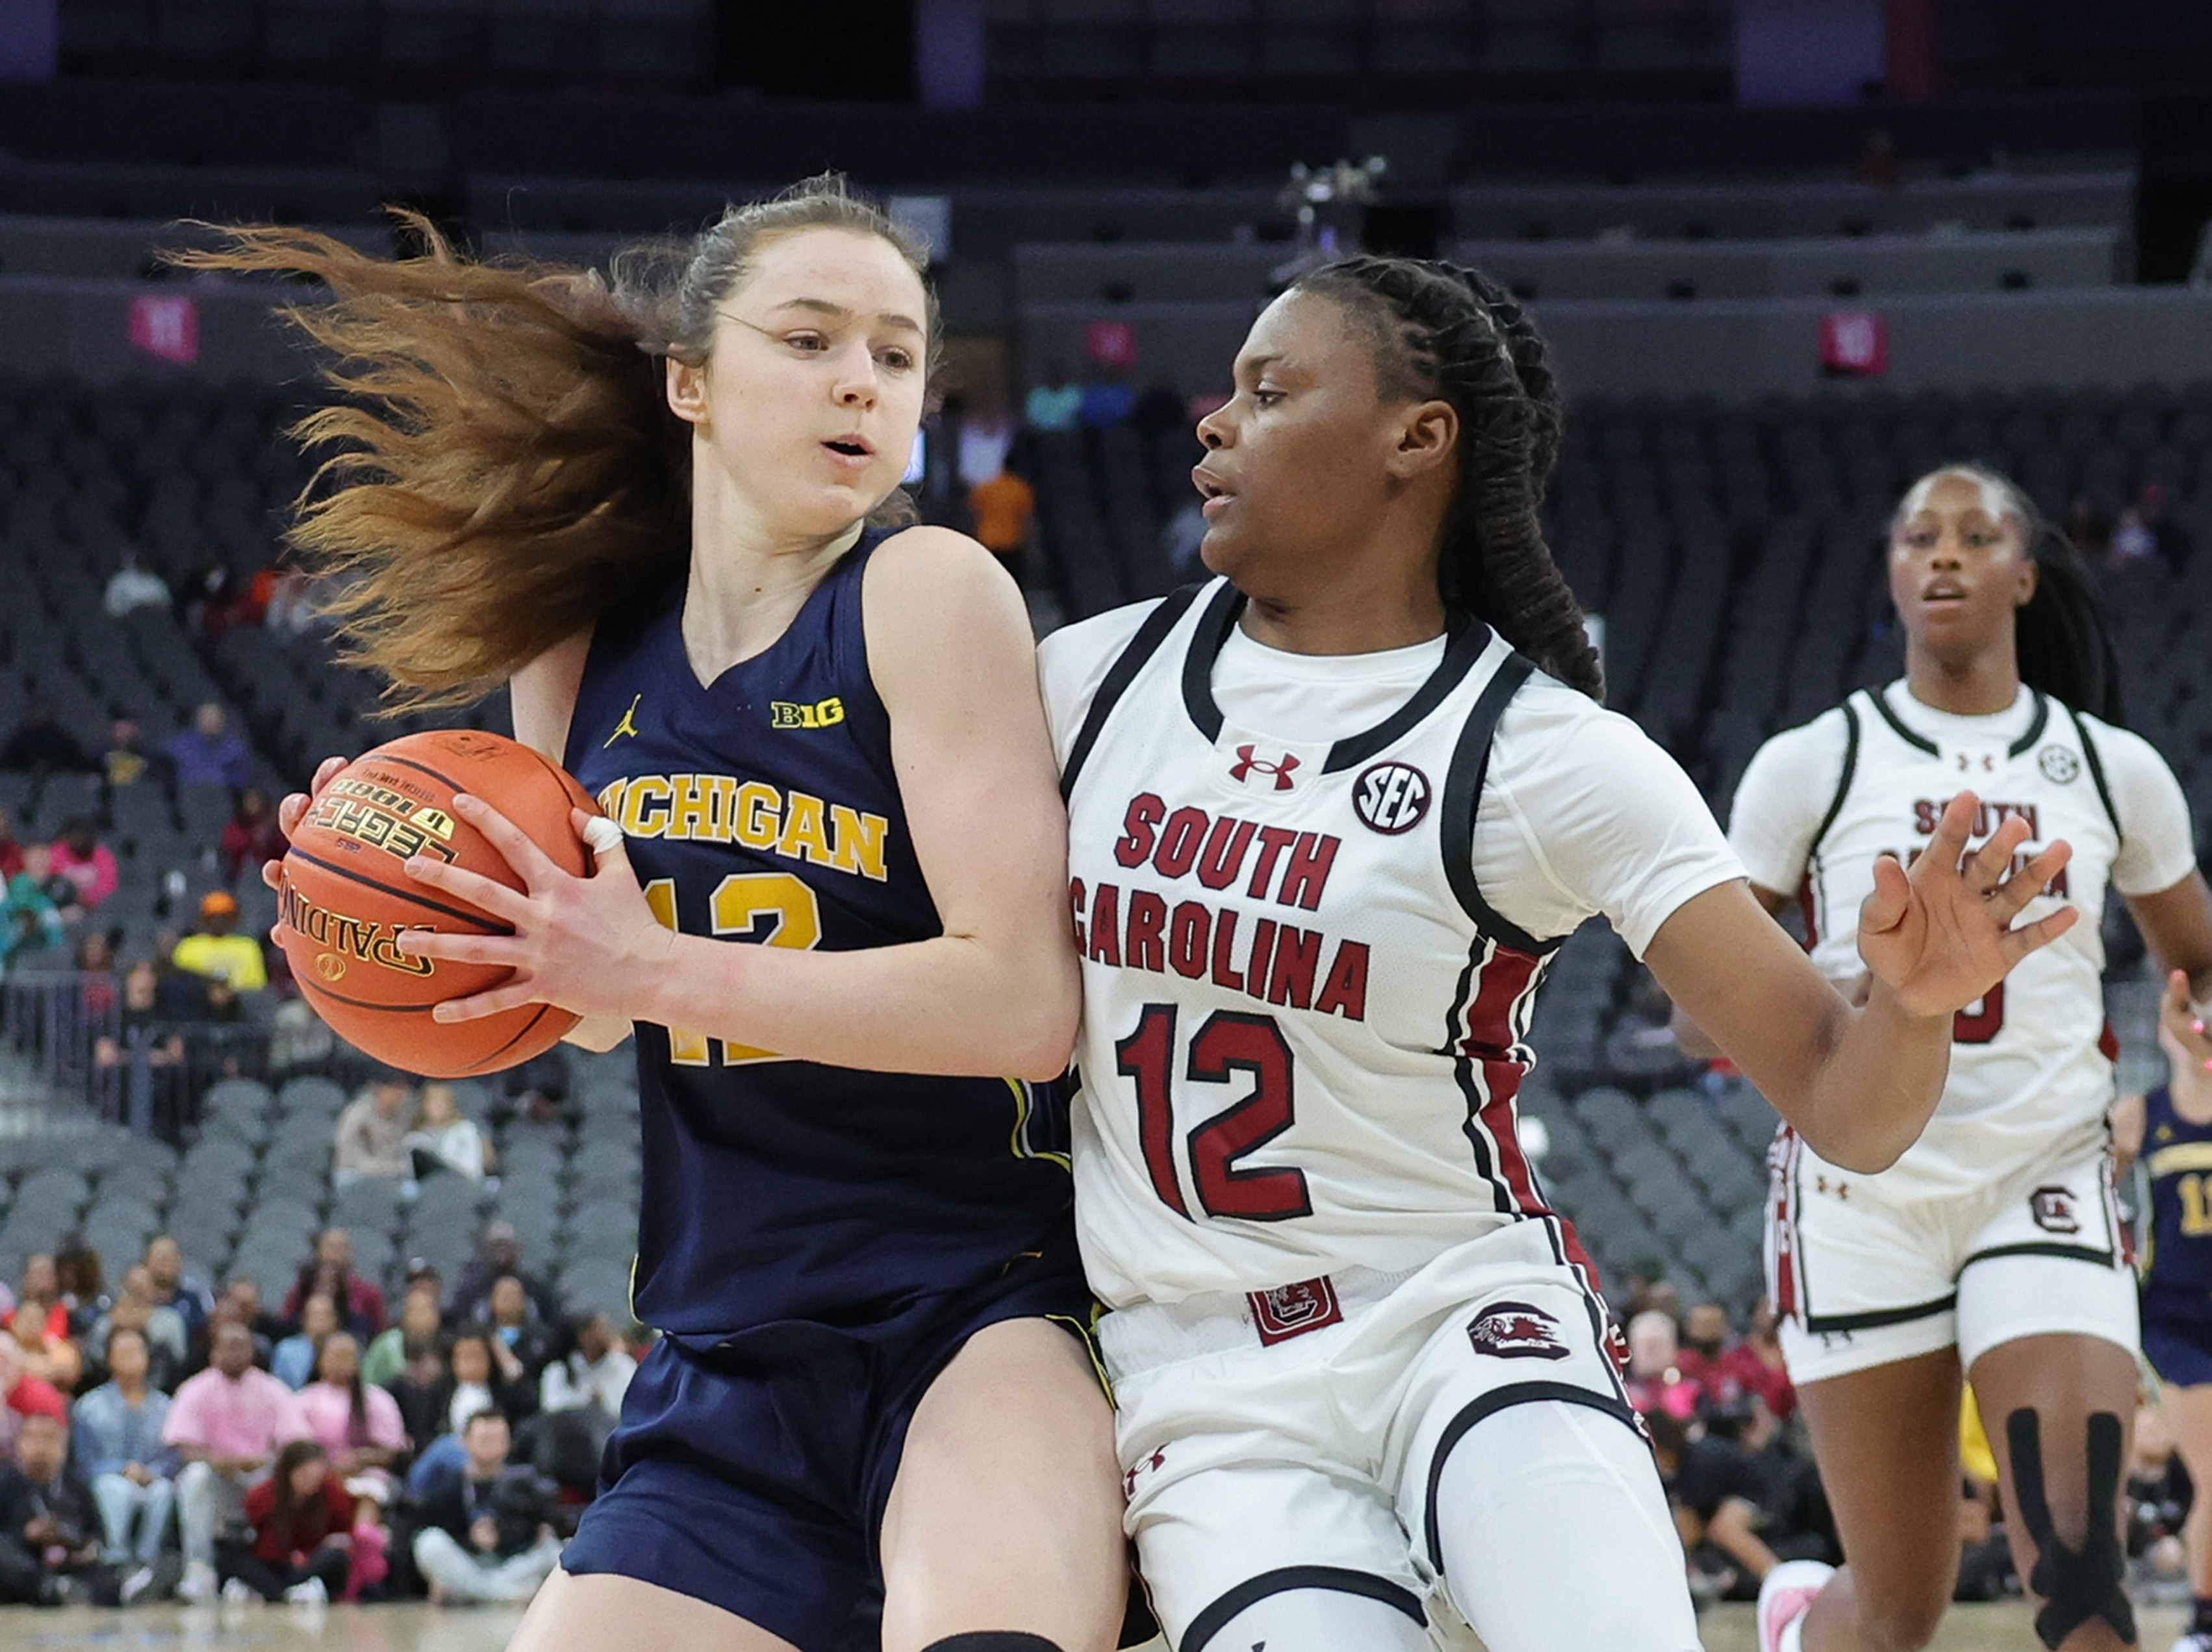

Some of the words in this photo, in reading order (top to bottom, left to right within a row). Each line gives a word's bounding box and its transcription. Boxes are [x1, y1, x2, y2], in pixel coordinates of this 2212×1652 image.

[1358, 766, 1425, 829] SEC
[1914, 800, 2038, 841] SUTH
[1114, 792, 1341, 911] SOUTH
[1115, 1003, 1314, 1224] 12
